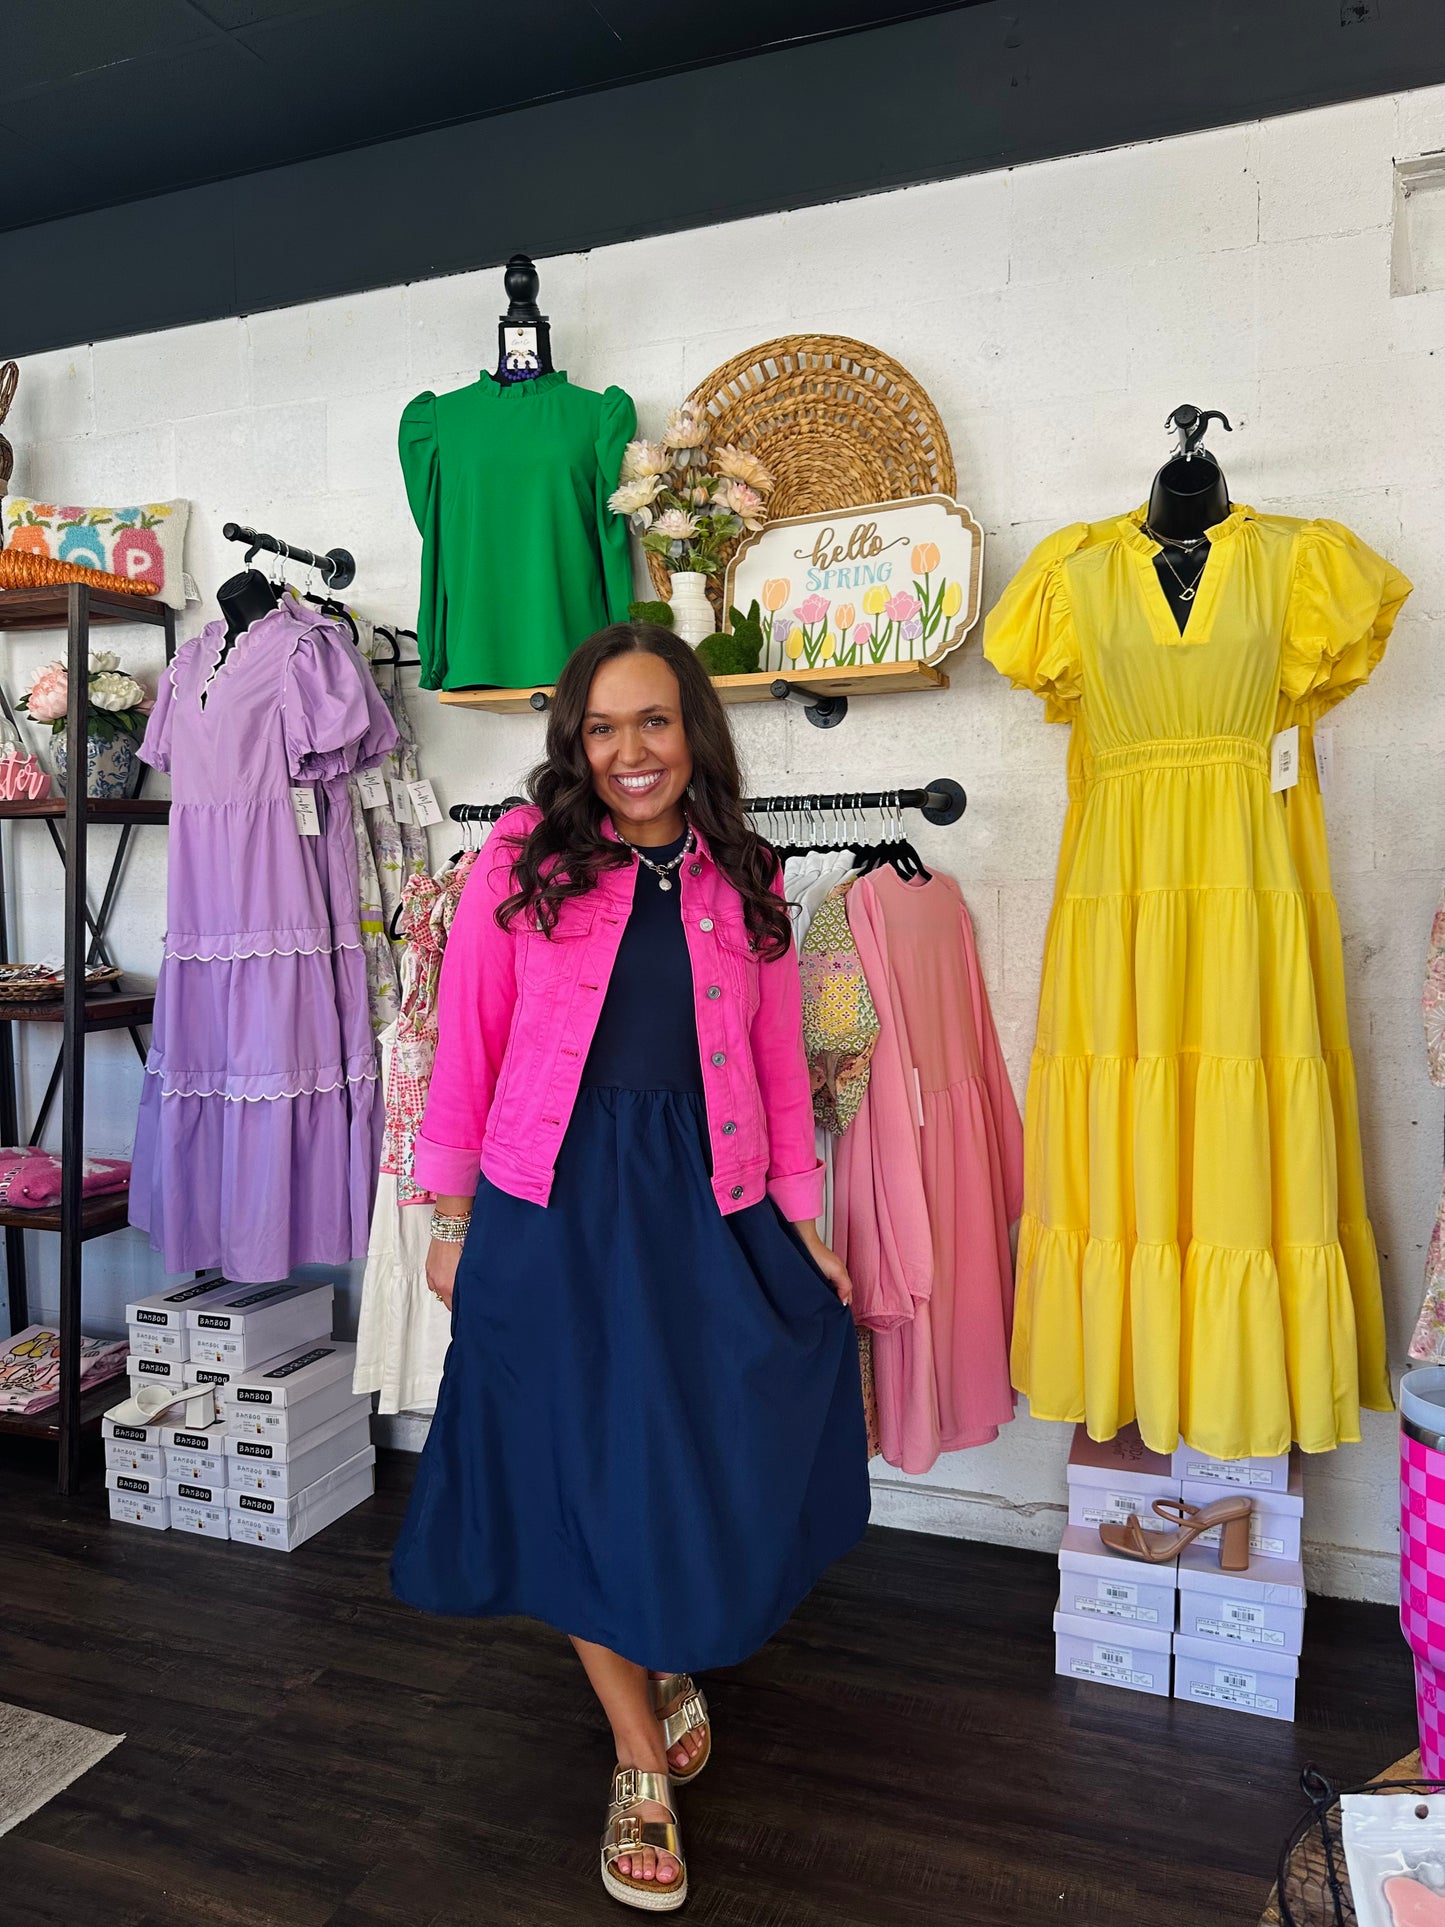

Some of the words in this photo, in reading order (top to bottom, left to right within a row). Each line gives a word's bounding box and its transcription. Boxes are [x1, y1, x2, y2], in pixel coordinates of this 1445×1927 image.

[794, 522, 910, 570] hello
[805, 562, 893, 591] SPRING
[138, 1312, 166, 1323] BAMBOO
[199, 1317, 229, 1328] BAMBOO
[140, 1362, 169, 1373] BAMBOO
[198, 1373, 228, 1384] BAMBOO
[239, 1391, 271, 1401] BAMBOO
[115, 1428, 145, 1439] BAMBOO
[175, 1435, 207, 1447] BAMBOO
[239, 1444, 270, 1455] BAMBOO
[118, 1480, 148, 1491] BAMBOO
[180, 1487, 210, 1499] BAMBOO
[241, 1498, 272, 1511] BAMBOO
